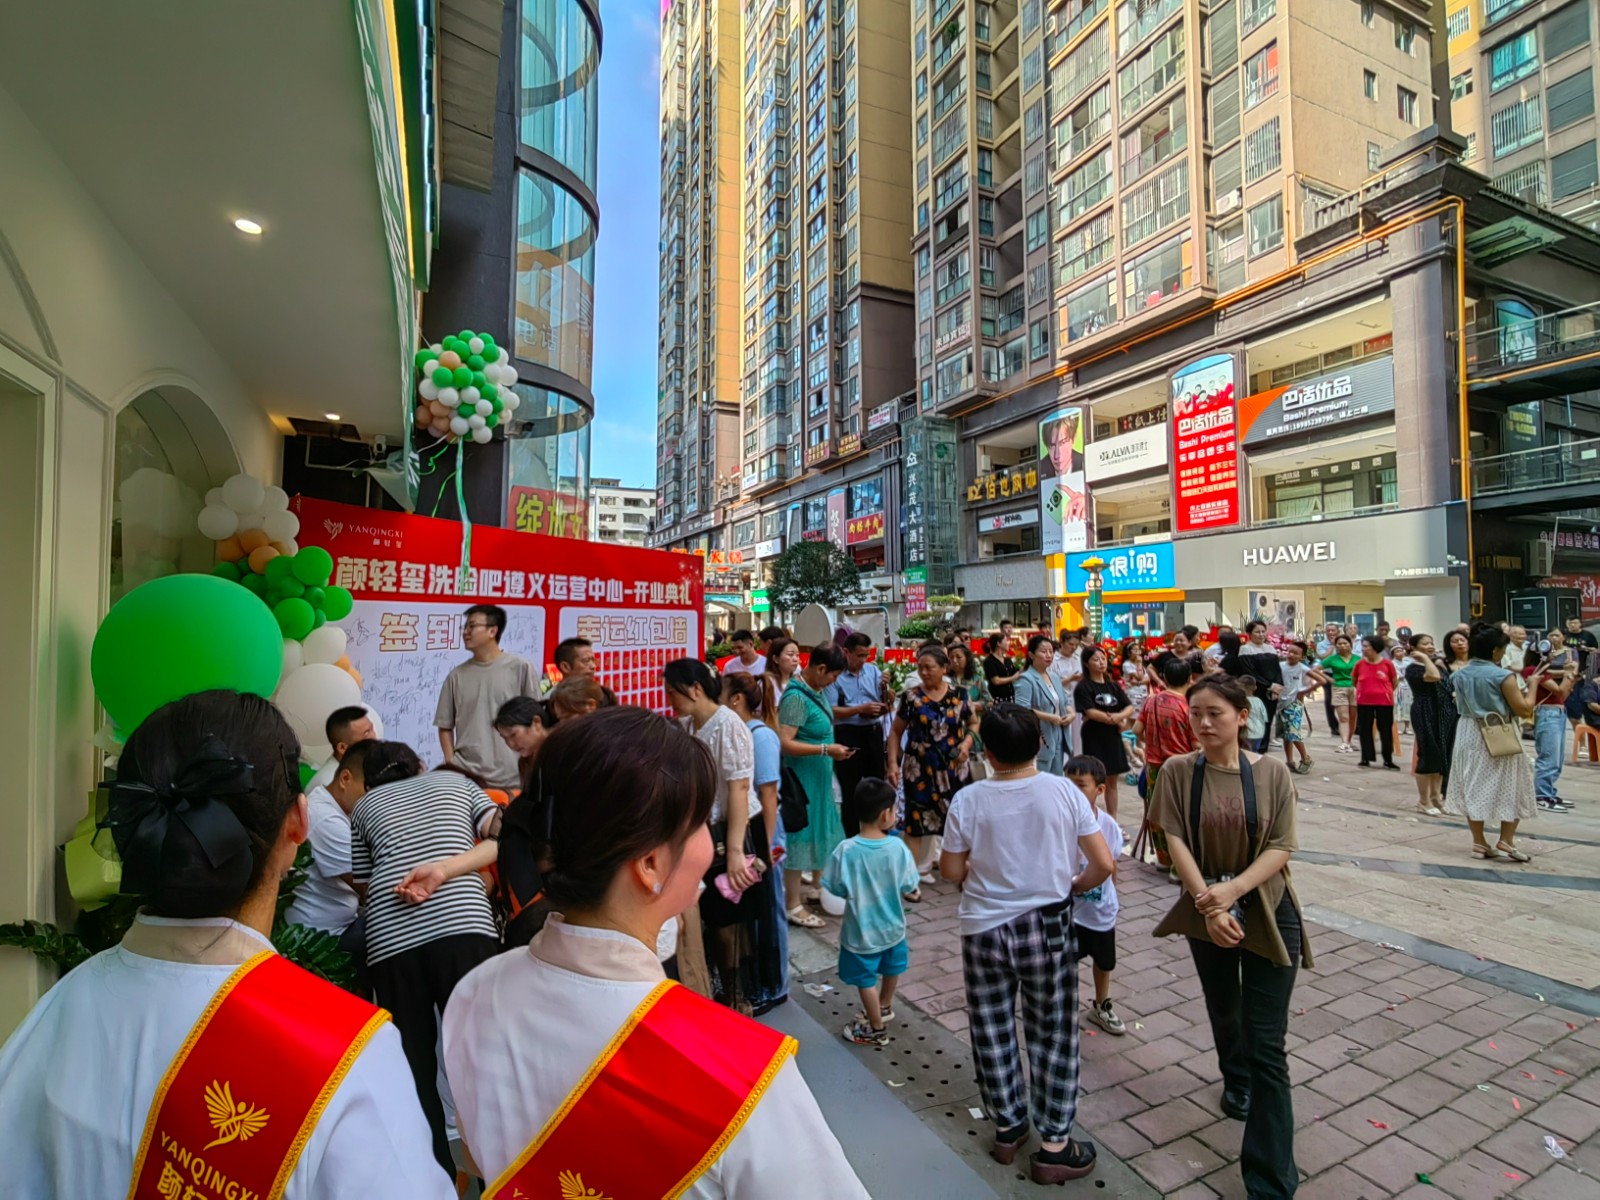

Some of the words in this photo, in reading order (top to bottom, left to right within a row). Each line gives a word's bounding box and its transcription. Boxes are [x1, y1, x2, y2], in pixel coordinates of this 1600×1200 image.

[1308, 400, 1348, 416] Premium
[1200, 429, 1234, 444] Premium
[349, 524, 403, 538] YANQINGXI
[1243, 541, 1336, 567] HUAWEI
[577, 615, 687, 647] 幸运红包墙
